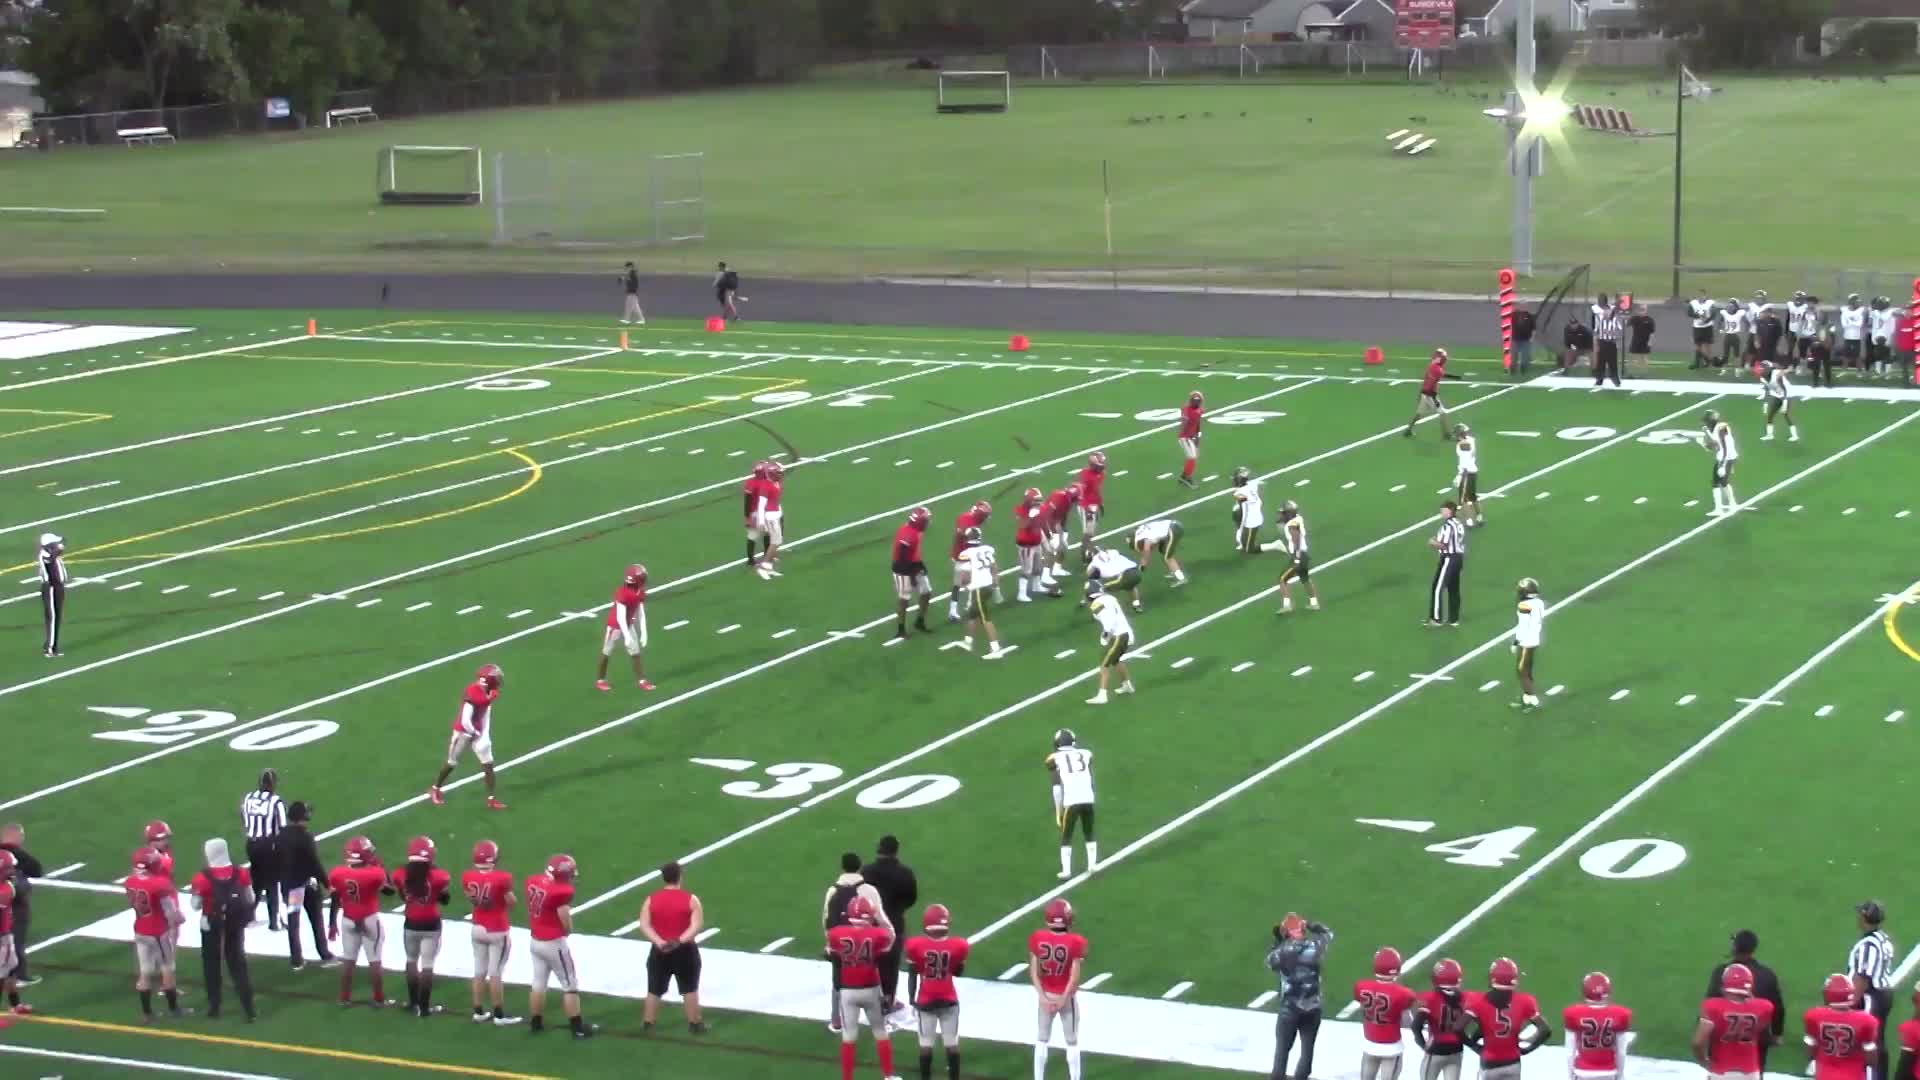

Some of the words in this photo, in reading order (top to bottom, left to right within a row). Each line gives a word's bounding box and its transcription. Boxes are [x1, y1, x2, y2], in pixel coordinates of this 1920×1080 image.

[1065, 751, 1086, 773] 13
[839, 937, 873, 968] 24
[1038, 943, 1069, 977] 29
[1360, 989, 1391, 1025] 22
[1495, 1003, 1512, 1038] 5
[1580, 1016, 1617, 1050] 26
[1819, 1021, 1855, 1058] 53
